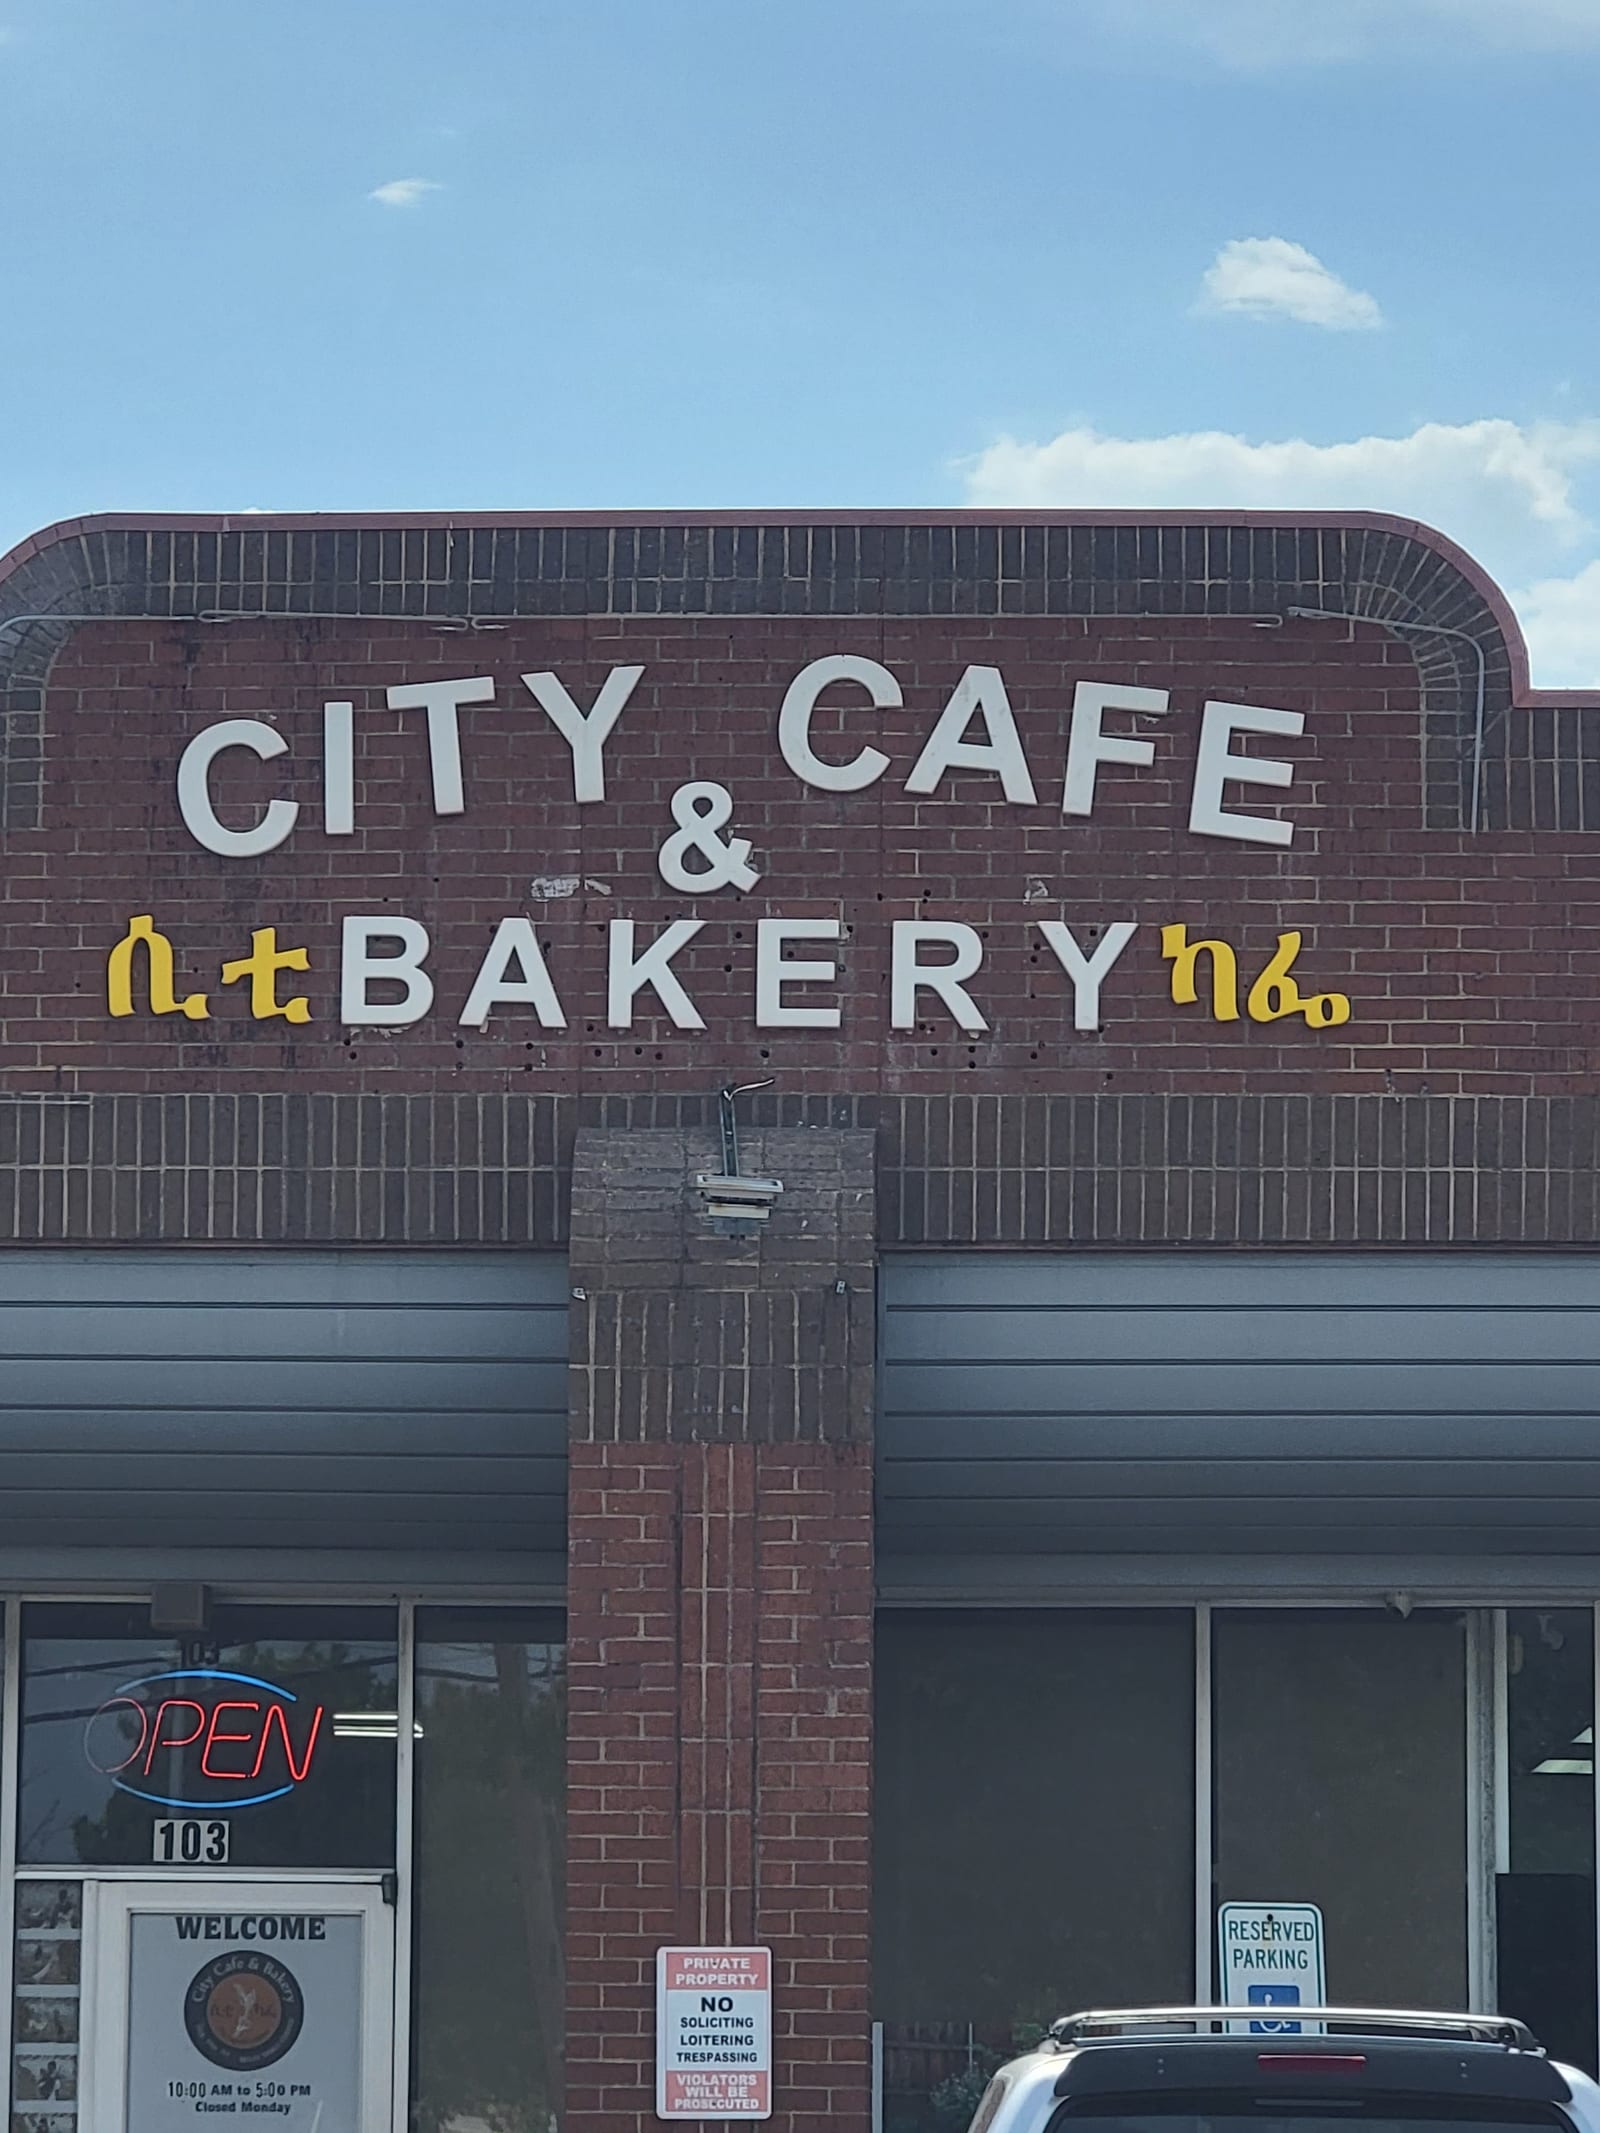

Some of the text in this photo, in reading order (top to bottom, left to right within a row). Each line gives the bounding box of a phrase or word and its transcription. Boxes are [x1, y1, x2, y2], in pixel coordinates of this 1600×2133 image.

[177, 655, 1305, 857] CITY CAFE
[658, 781, 762, 893] &
[108, 914, 313, 1024] ሲቲ
[341, 915, 1138, 1031] BAKERY
[84, 1697, 324, 1781] OPEN
[160, 1821, 226, 1861] 103
[176, 1916, 326, 1940] WELCOME
[1228, 1920, 1315, 1942] RESERVED
[683, 1957, 751, 1970] PRIVATE
[1233, 1948, 1308, 1970] PARKING
[192, 1976, 214, 2003] City
[263, 1961, 295, 2003] Bakery
[675, 1973, 758, 1986] PROPERTY
[700, 1996, 734, 2013] NO
[680, 2017, 754, 2029] SOLICITING
[680, 2034, 754, 2046] LOITERING
[676, 2052, 758, 2063] TRESPASSING
[168, 2081, 311, 2098] 10:00 AM to 5:00 PM
[676, 2074, 757, 2087] VIOLATORS
[685, 2086, 748, 2098] WILL BE
[195, 2101, 291, 2116] Closed Monday
